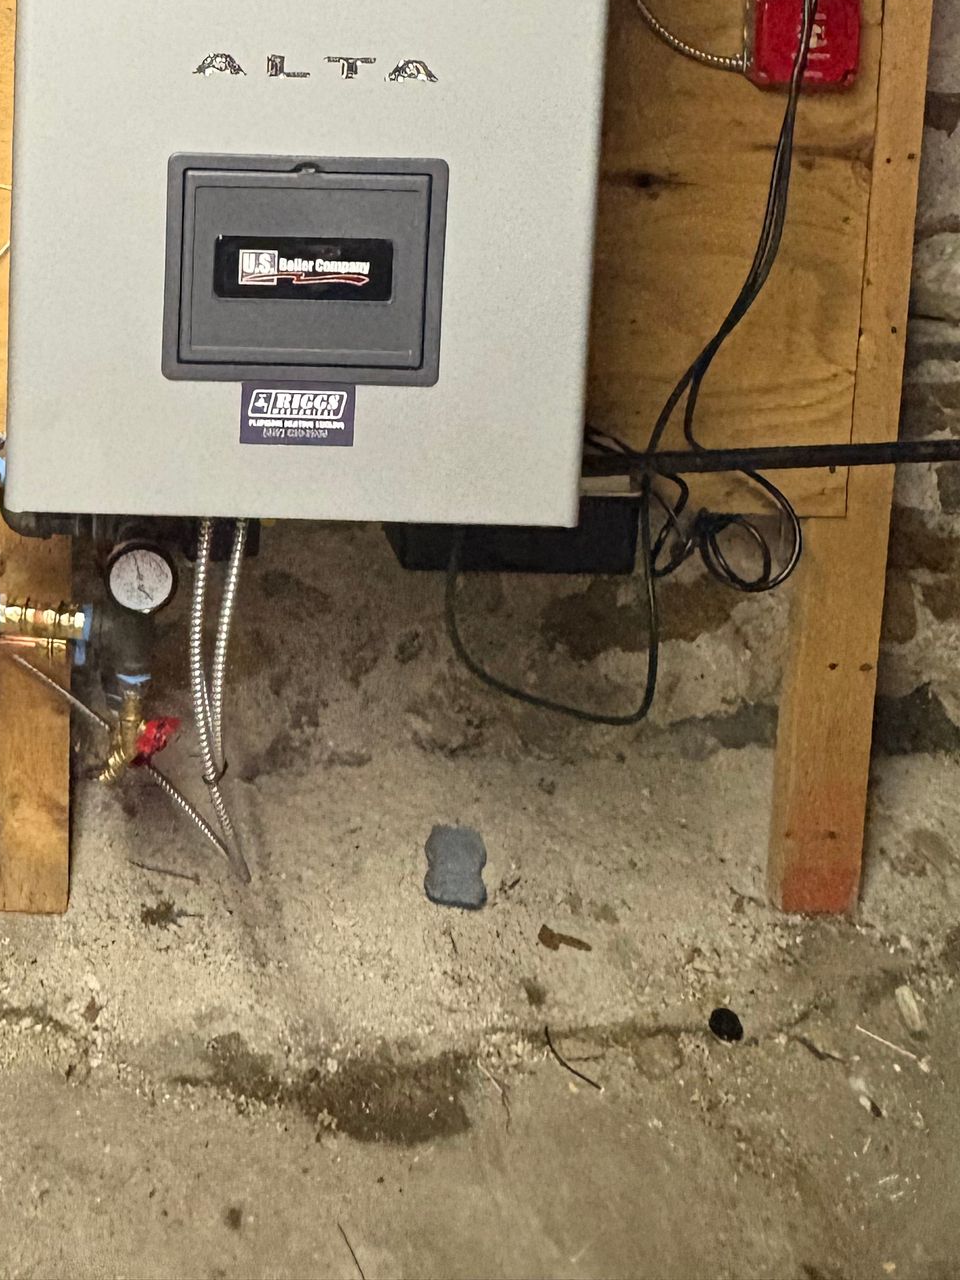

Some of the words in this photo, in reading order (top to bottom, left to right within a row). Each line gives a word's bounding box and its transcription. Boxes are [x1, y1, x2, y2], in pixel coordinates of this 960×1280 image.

[192, 53, 438, 83] ALTA
[243, 253, 275, 274] U.S.
[315, 258, 370, 275] Company
